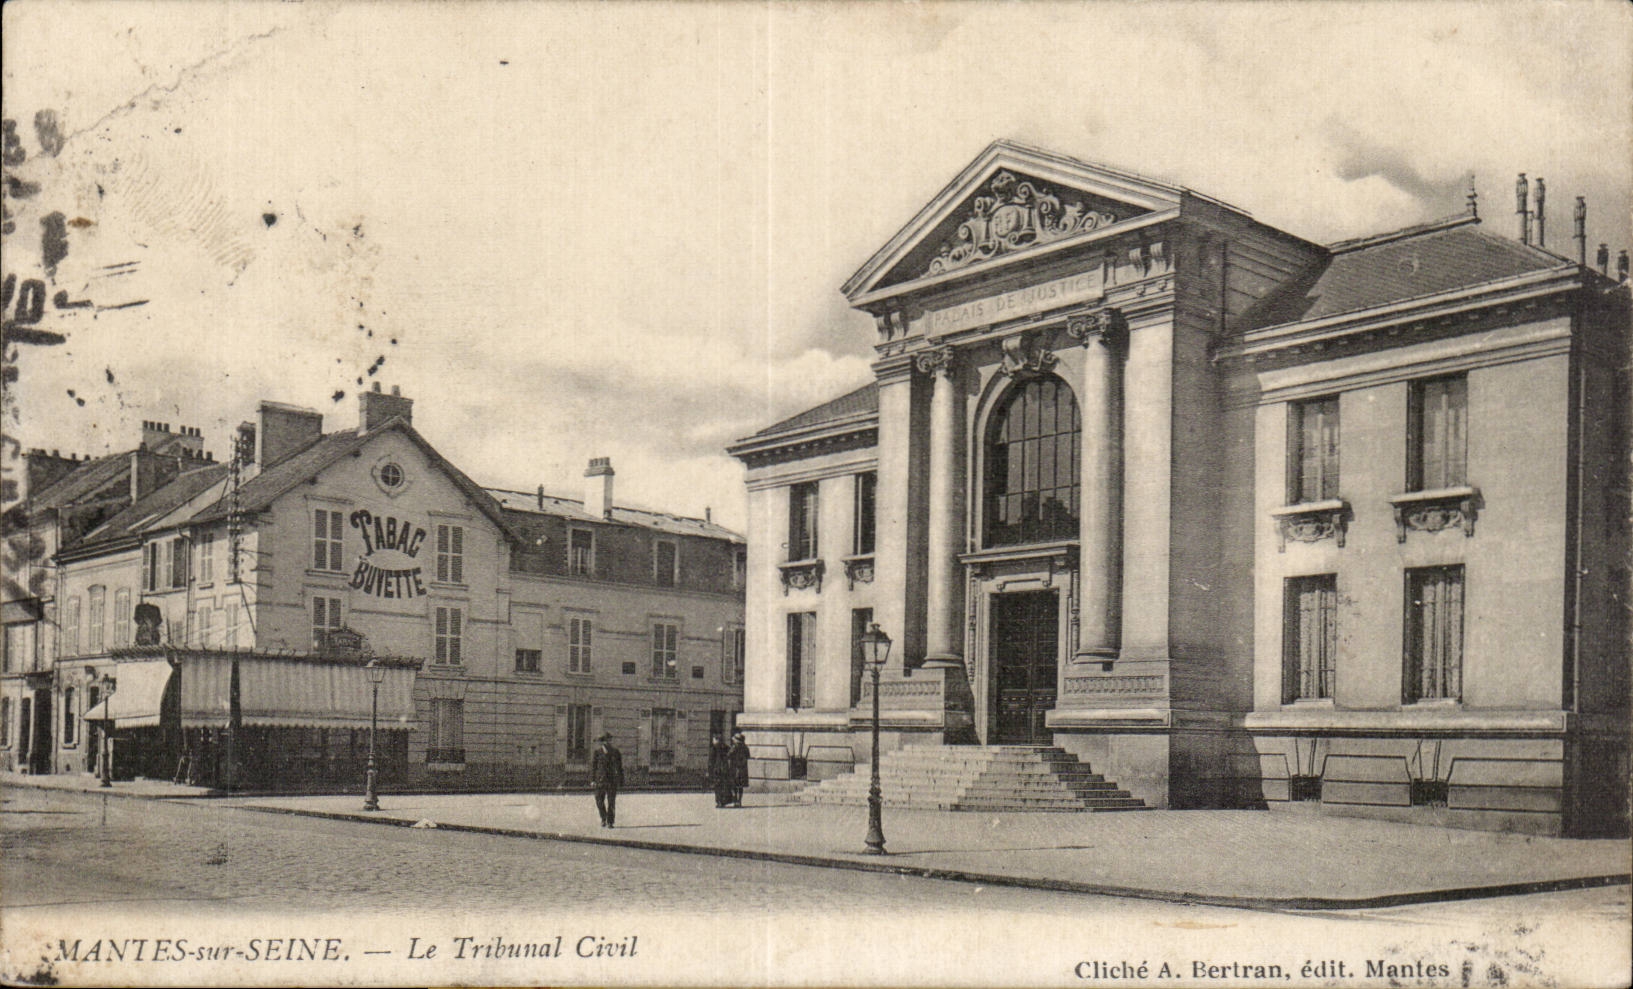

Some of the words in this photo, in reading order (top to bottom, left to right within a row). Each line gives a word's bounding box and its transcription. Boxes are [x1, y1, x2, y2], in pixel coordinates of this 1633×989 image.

[933, 302, 985, 328] PALAIS
[996, 293, 1016, 312] DE
[1028, 272, 1098, 304] JUSTICE
[350, 509, 427, 558] TABAC
[348, 556, 427, 599] BUVETTE
